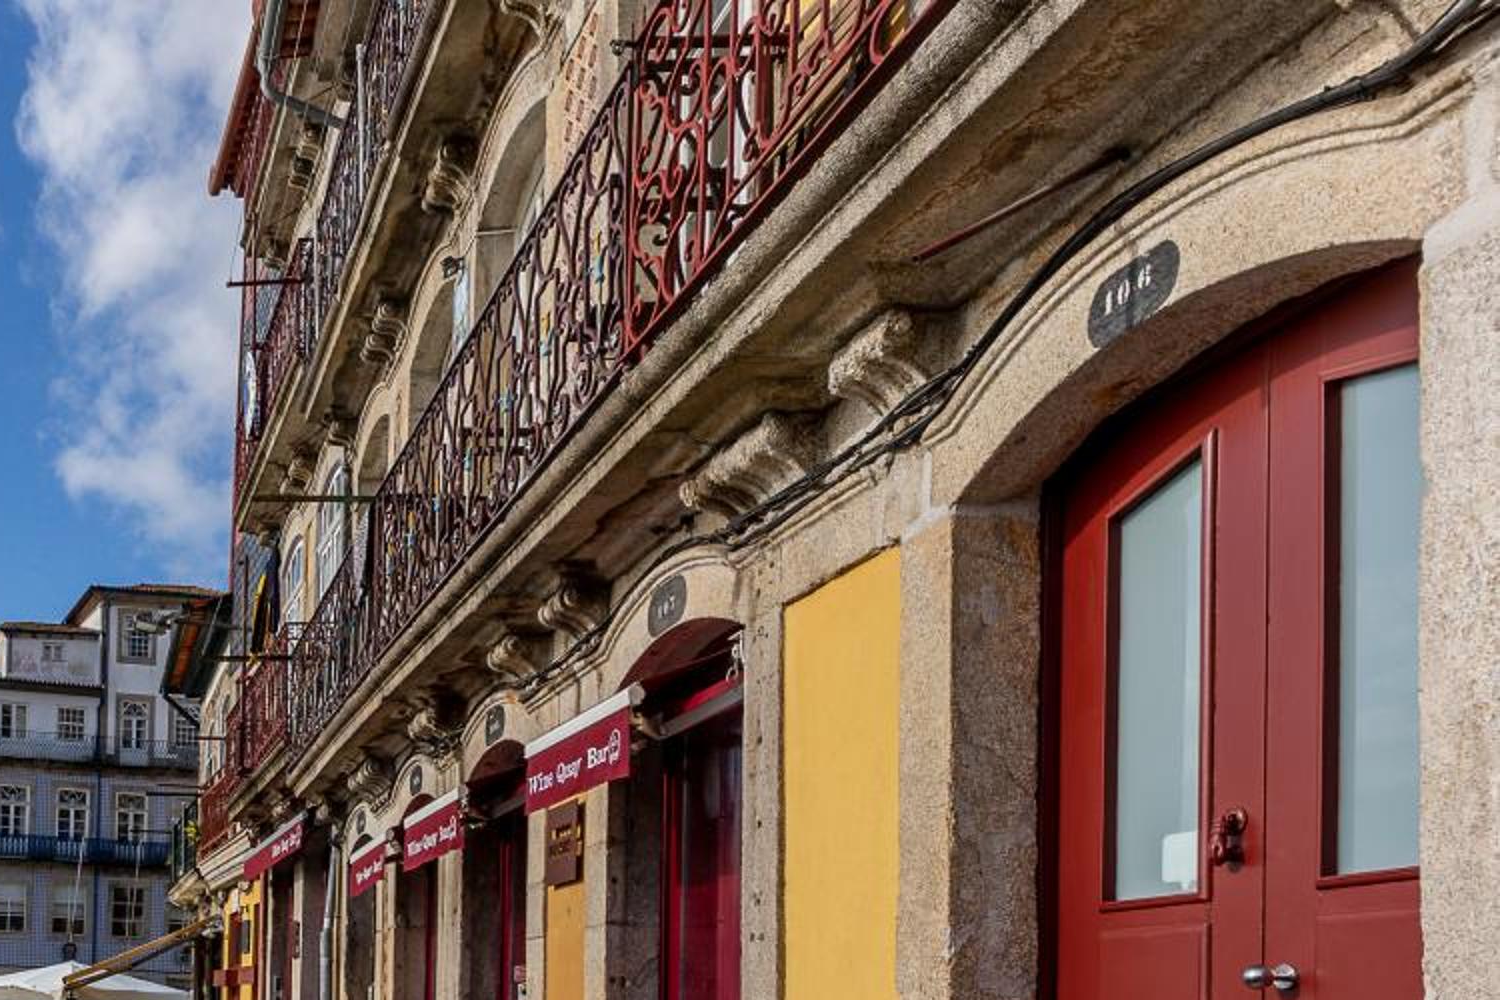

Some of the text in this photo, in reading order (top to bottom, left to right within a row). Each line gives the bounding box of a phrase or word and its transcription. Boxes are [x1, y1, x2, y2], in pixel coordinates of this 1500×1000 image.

[1104, 263, 1151, 317] 106
[528, 746, 610, 796] Wine Quay Bar
